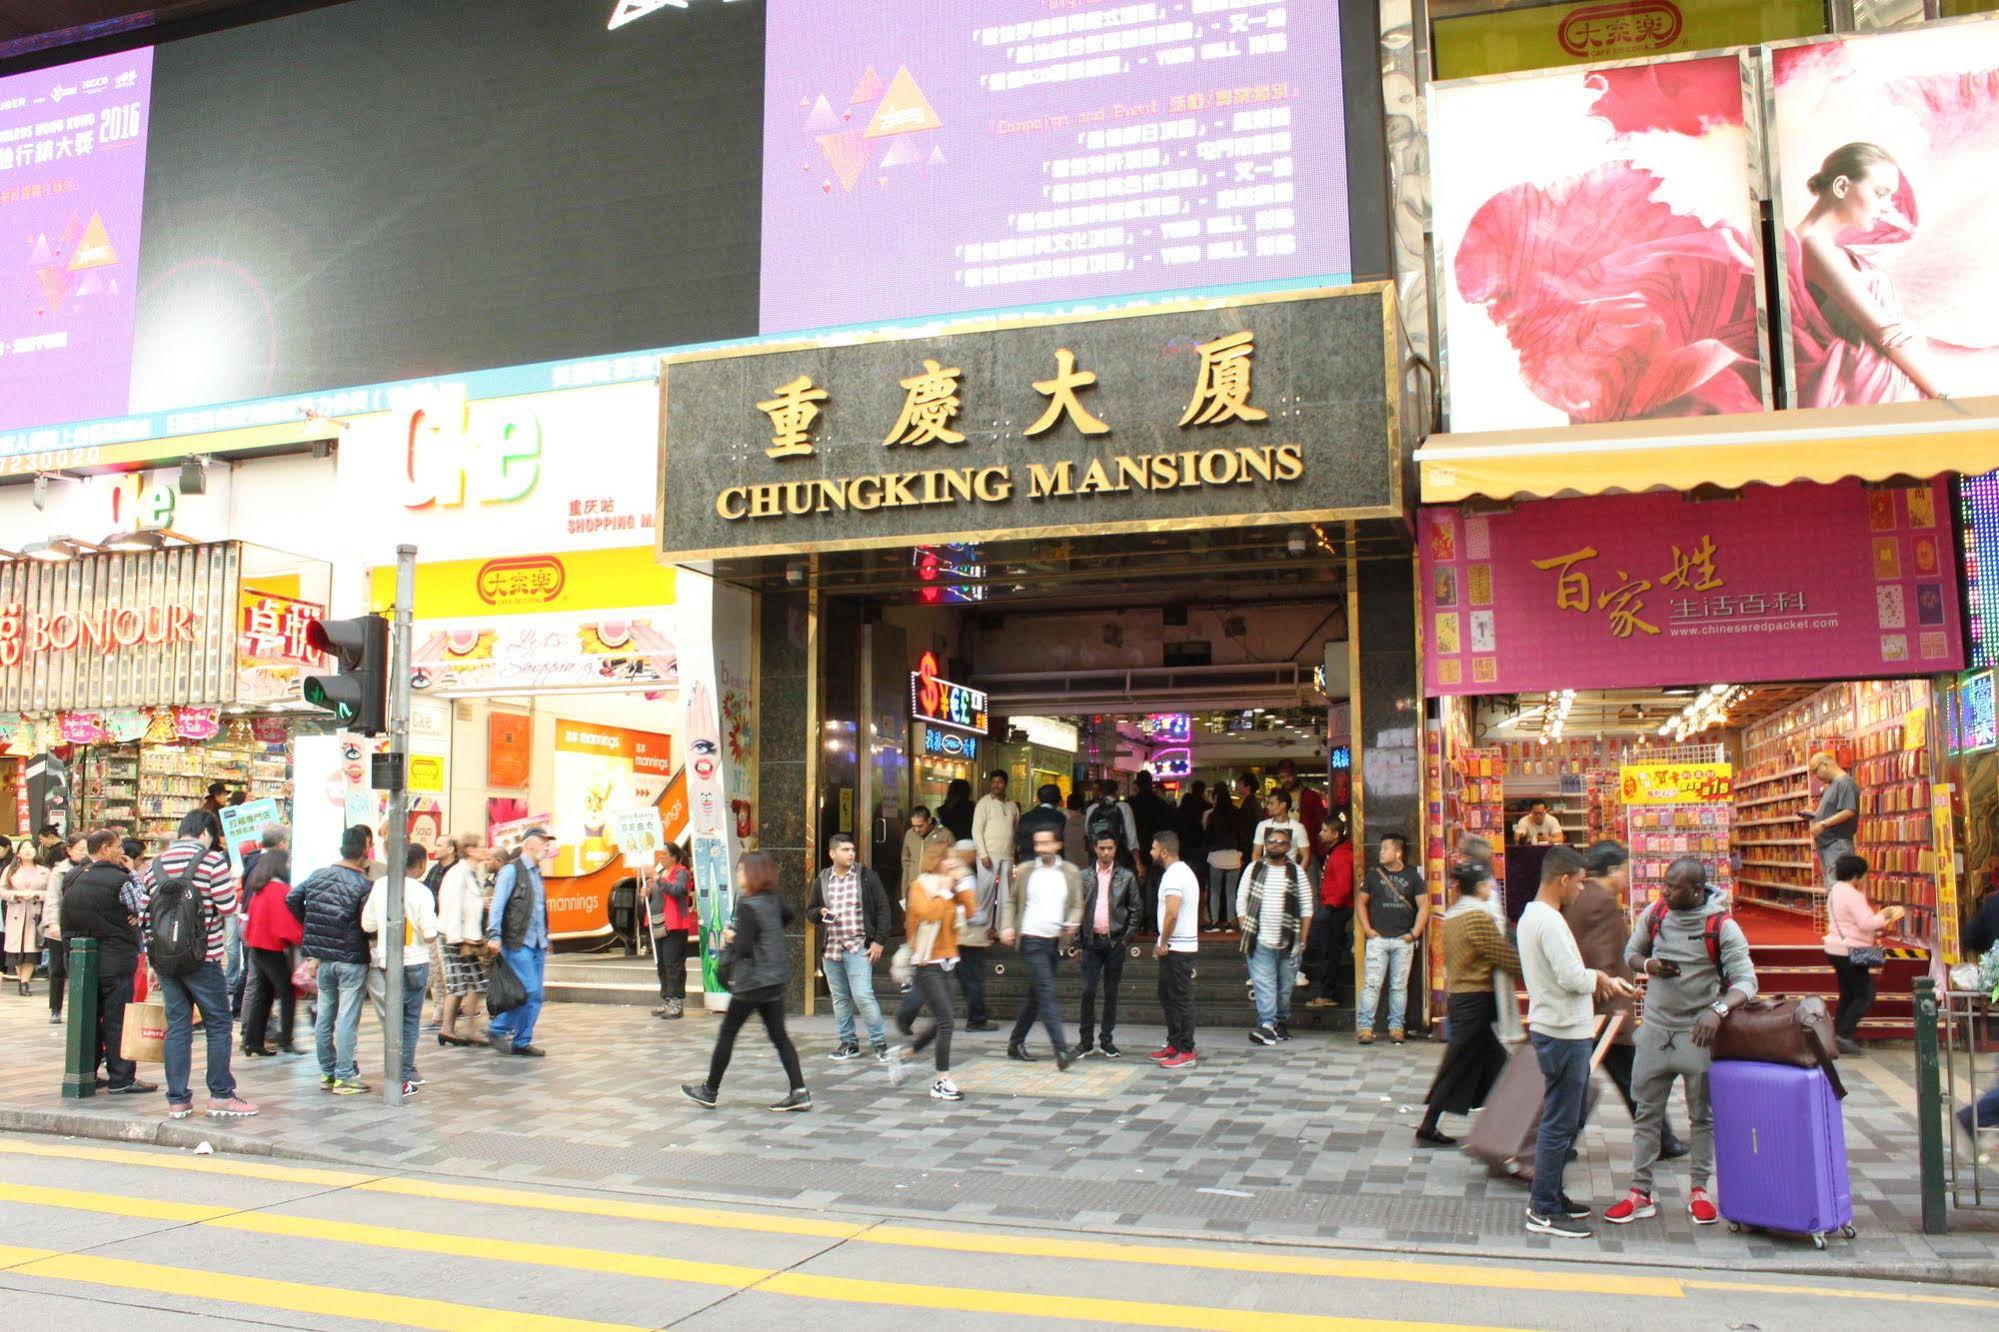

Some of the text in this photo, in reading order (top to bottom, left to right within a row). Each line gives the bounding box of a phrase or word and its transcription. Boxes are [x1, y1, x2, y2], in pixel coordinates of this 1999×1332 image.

[99, 102, 140, 143] 2016
[716, 443, 1304, 521] CHUNGKING MANSIONS
[567, 513, 636, 534] SHOPPING
[1531, 534, 1724, 638] 百家姓
[1668, 591, 1806, 619] 生活百科
[32, 604, 194, 655] BONJOUR
[1670, 617, 1839, 637] www.chineseredpacket.com
[580, 732, 620, 751] mannings
[635, 756, 669, 771] mannings
[547, 894, 599, 913] mannings
